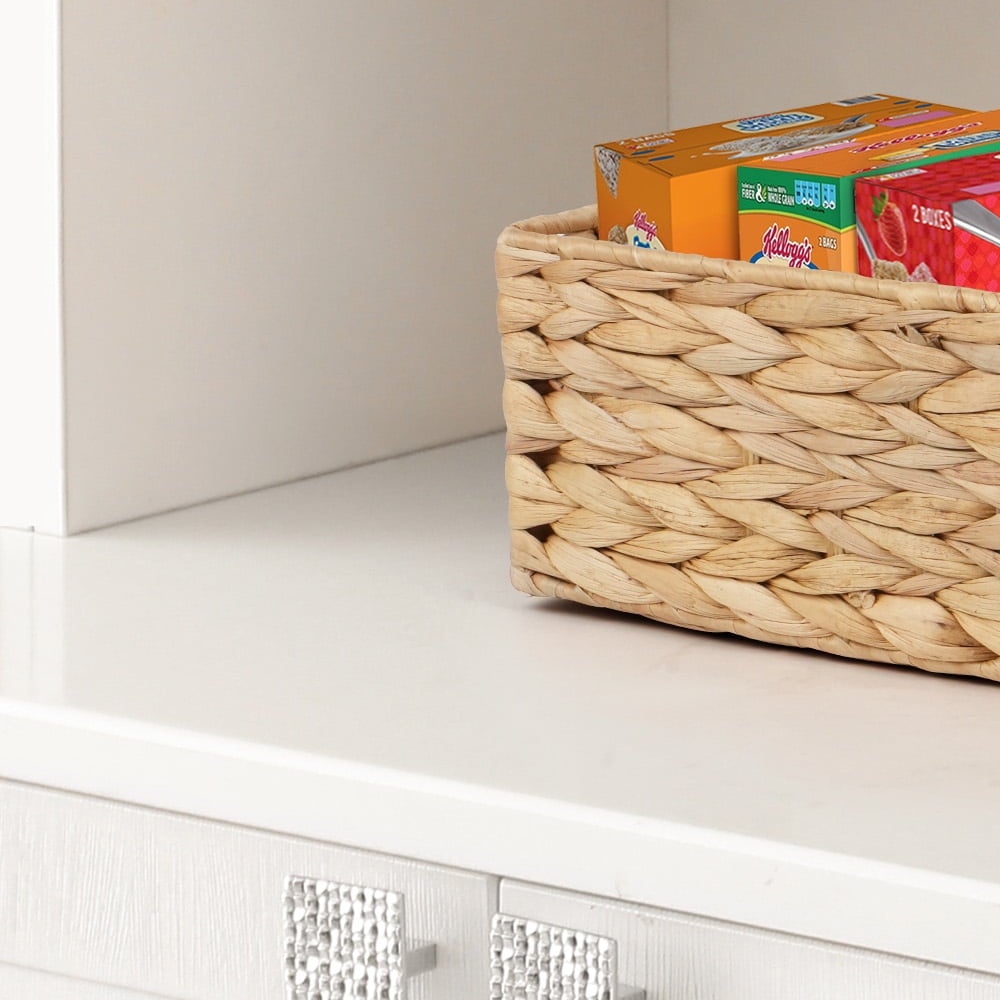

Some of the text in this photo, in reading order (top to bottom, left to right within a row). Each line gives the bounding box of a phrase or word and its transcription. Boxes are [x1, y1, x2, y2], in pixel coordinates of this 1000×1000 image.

[911, 204, 952, 231] 2 BOXES
[762, 223, 812, 268] Kellogg's
[823, 238, 837, 249] BAGS
